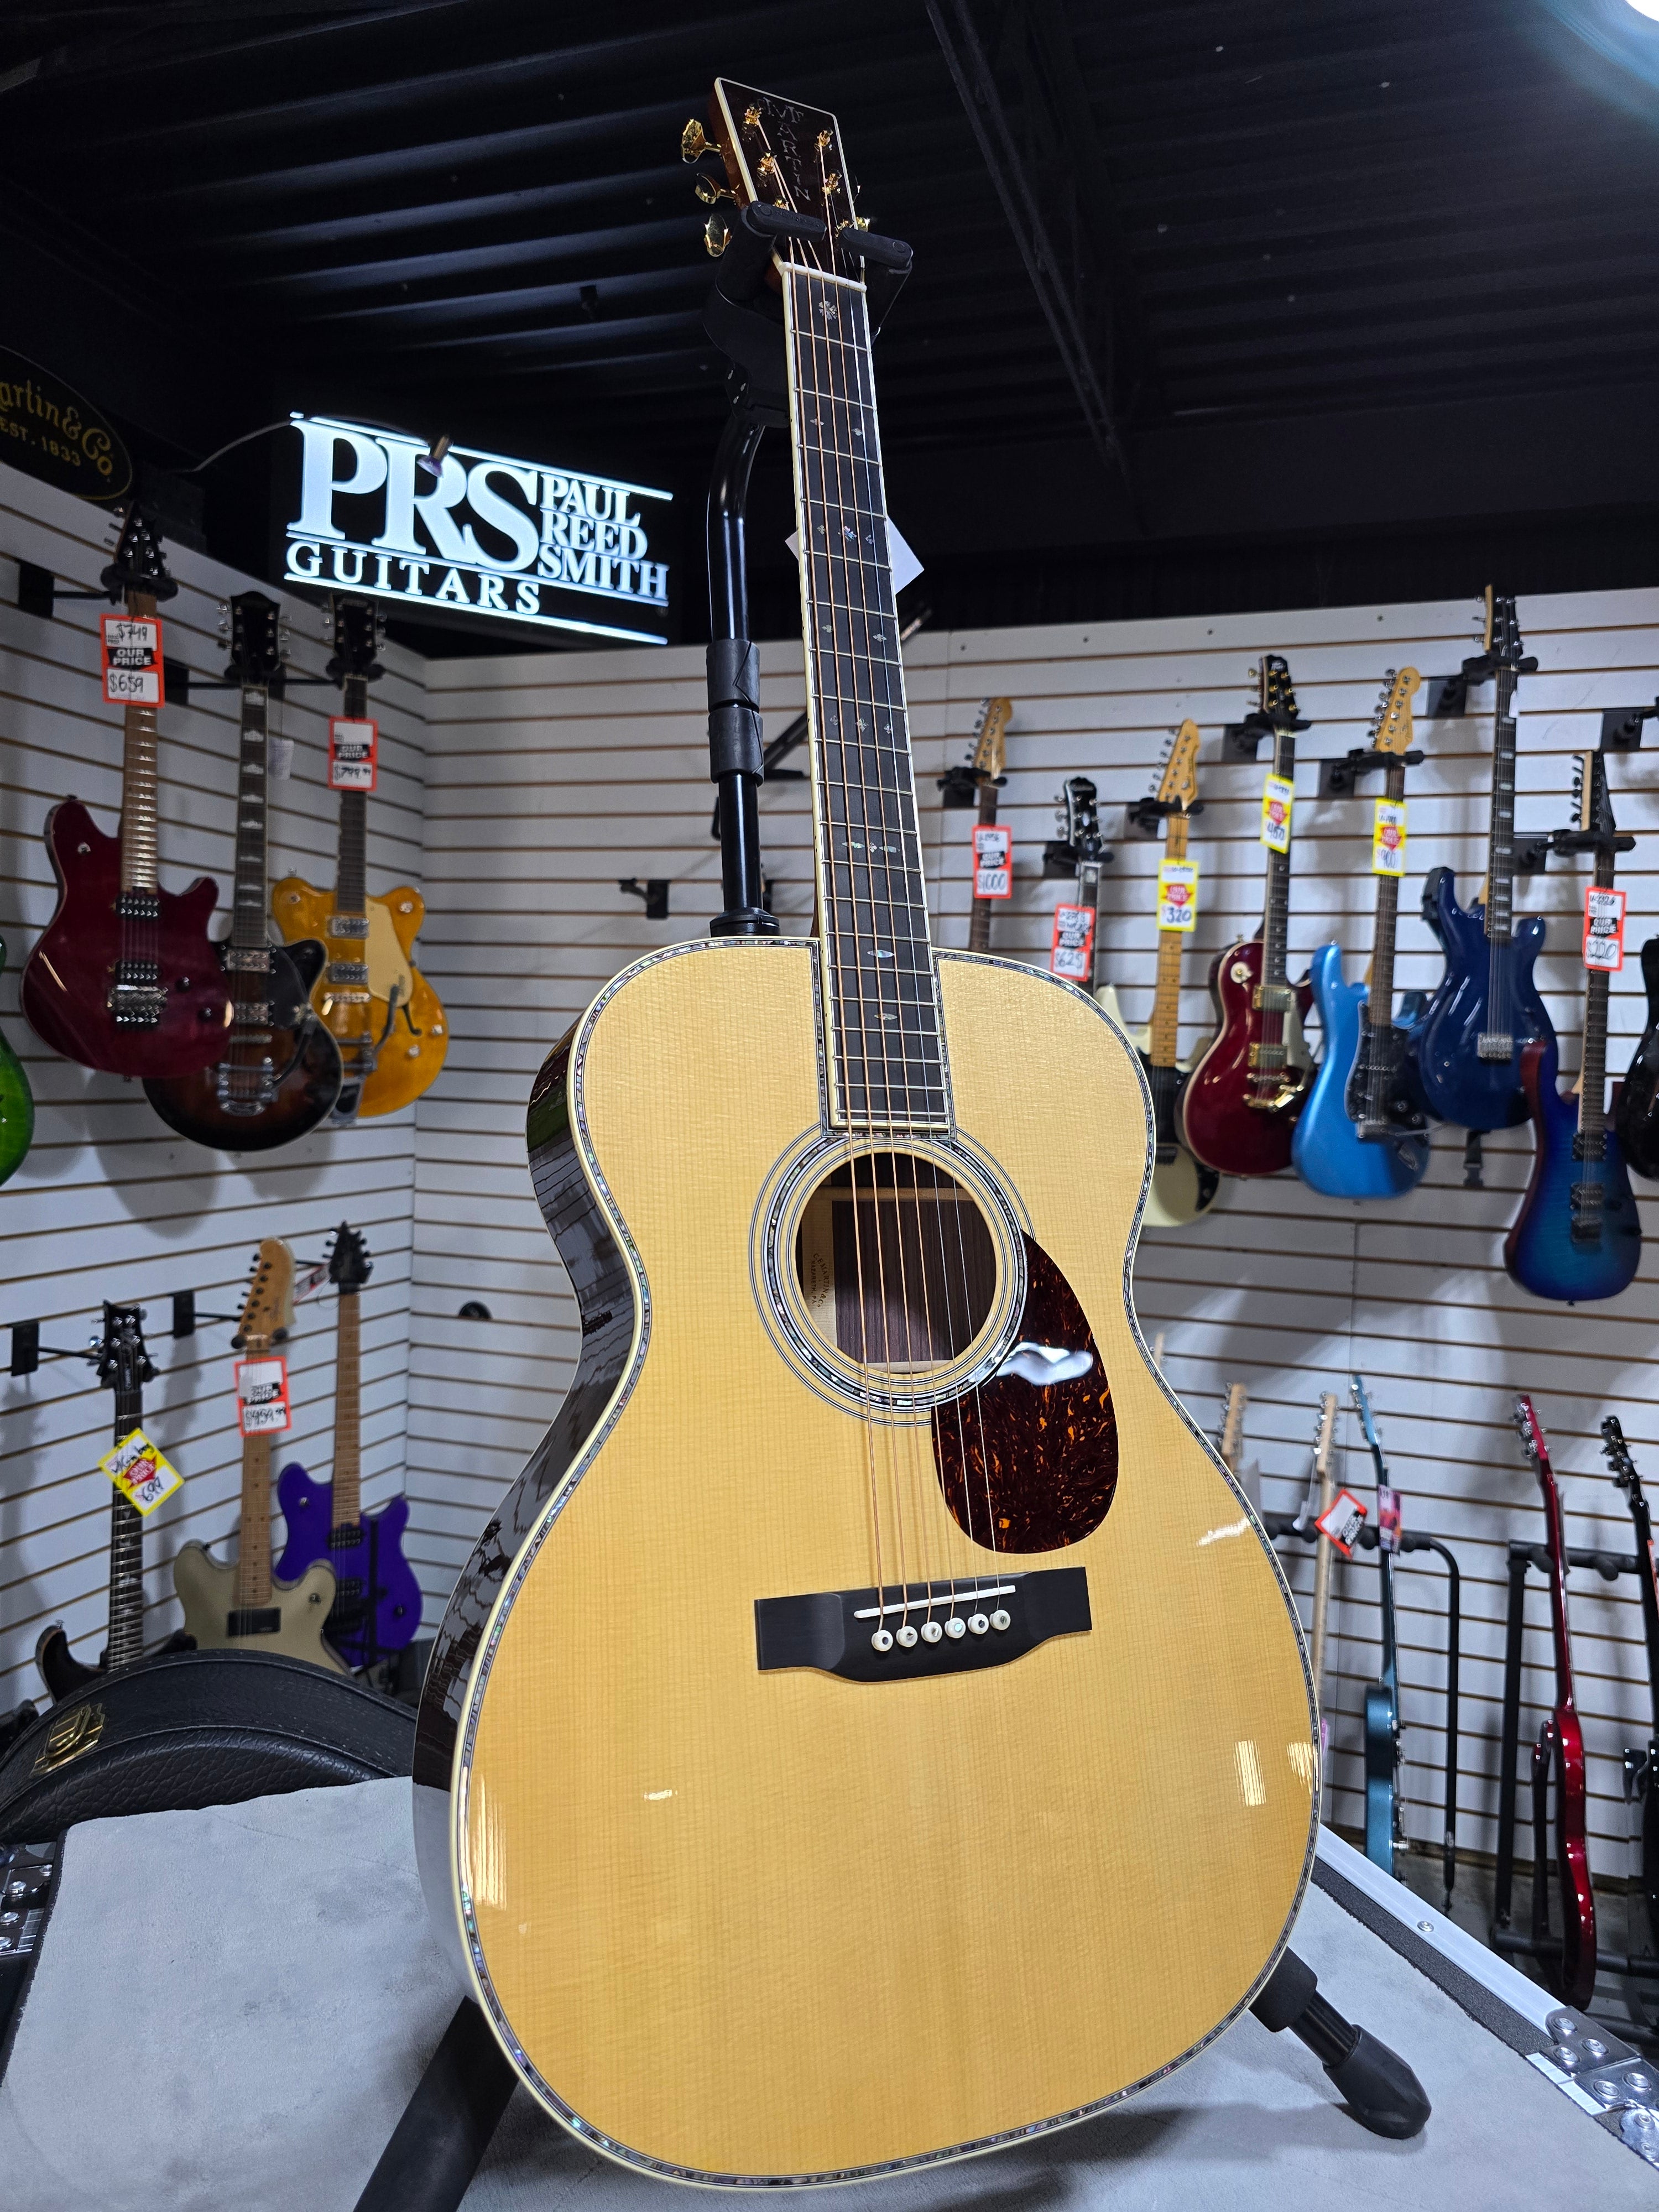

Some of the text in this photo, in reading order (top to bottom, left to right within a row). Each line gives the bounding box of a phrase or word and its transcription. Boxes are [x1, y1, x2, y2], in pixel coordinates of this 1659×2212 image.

[0, 379, 59, 428] artin
[286, 419, 540, 572] PRS
[539, 472, 641, 527] PAUL
[538, 508, 649, 561] REED
[286, 540, 540, 615] GUITARS
[538, 544, 670, 601] SMITH
[115, 623, 148, 641] $749
[112, 657, 152, 666] PRICE
[116, 649, 145, 658] OUR
[109, 672, 144, 693] $659
[980, 858, 1005, 868] PRICE
[982, 852, 1000, 860] OUR
[1590, 925, 1617, 935] PRICE
[1593, 917, 1613, 926] OUR
[1058, 938, 1085, 947] PRICE
[820, 1263, 830, 1293] MARTIN
[129, 1458, 149, 1478] OUR
[131, 1461, 156, 1485] PRICE
[1342, 1515, 1357, 1537] OUR
